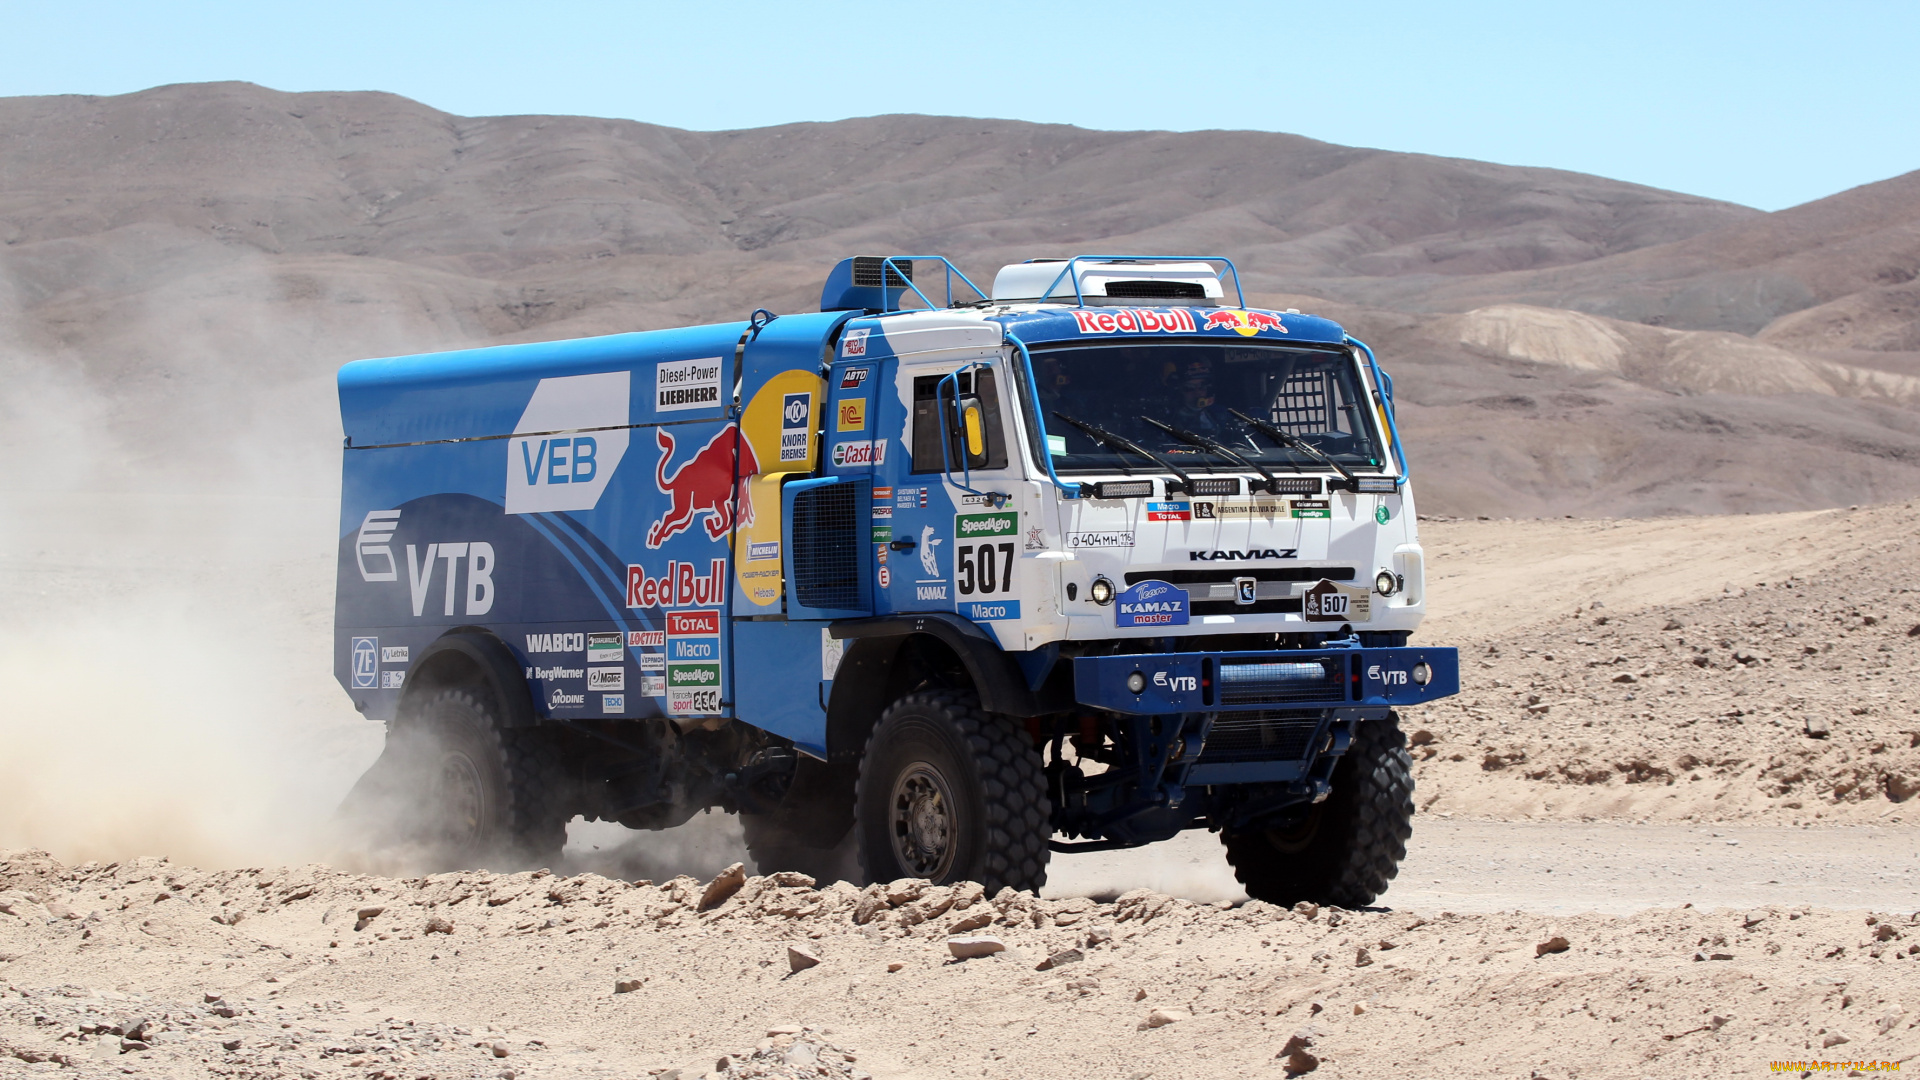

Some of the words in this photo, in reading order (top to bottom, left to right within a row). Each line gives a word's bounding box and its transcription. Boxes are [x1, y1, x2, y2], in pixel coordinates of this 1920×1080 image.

[1069, 309, 1139, 333] Red
[1136, 308, 1197, 333] Bull
[660, 365, 718, 383] Diesel-Power
[844, 370, 866, 380] АВТО
[660, 387, 717, 405] LIEBHERR
[782, 433, 807, 447] KNORR
[781, 448, 806, 460] BREMSE
[522, 437, 597, 486] VEB
[1249, 505, 1269, 513] BOLIVIA
[1270, 505, 1285, 513] CHILE
[961, 518, 1011, 534] SpeedAgro
[1120, 533, 1132, 541] 116
[752, 546, 778, 556] MICHELIN
[1190, 549, 1297, 560] KAMAZ
[958, 543, 1015, 595] 507
[406, 541, 495, 617] VTB
[627, 560, 676, 608] Red
[677, 558, 726, 606] Bull
[880, 570, 887, 584] E
[916, 586, 947, 600] KAMAZ
[1136, 584, 1167, 601] Team
[972, 604, 1005, 618] Macro
[1121, 601, 1182, 614] KAMAZ
[1324, 596, 1347, 612] 507
[673, 616, 713, 631] TOTAL
[1134, 613, 1172, 623] master
[526, 633, 584, 652] WABCO
[629, 632, 663, 645] LOCTITE
[676, 641, 711, 657] Macro
[355, 649, 375, 677] ZF
[535, 666, 584, 682] BorgWarner
[673, 669, 714, 683] SpeedAgro
[1381, 671, 1408, 685] VTB
[1169, 676, 1197, 692] VTB
[552, 695, 584, 704] MODINE
[672, 690, 692, 699] francetv
[694, 691, 716, 712] 234
[673, 700, 692, 712] sport
